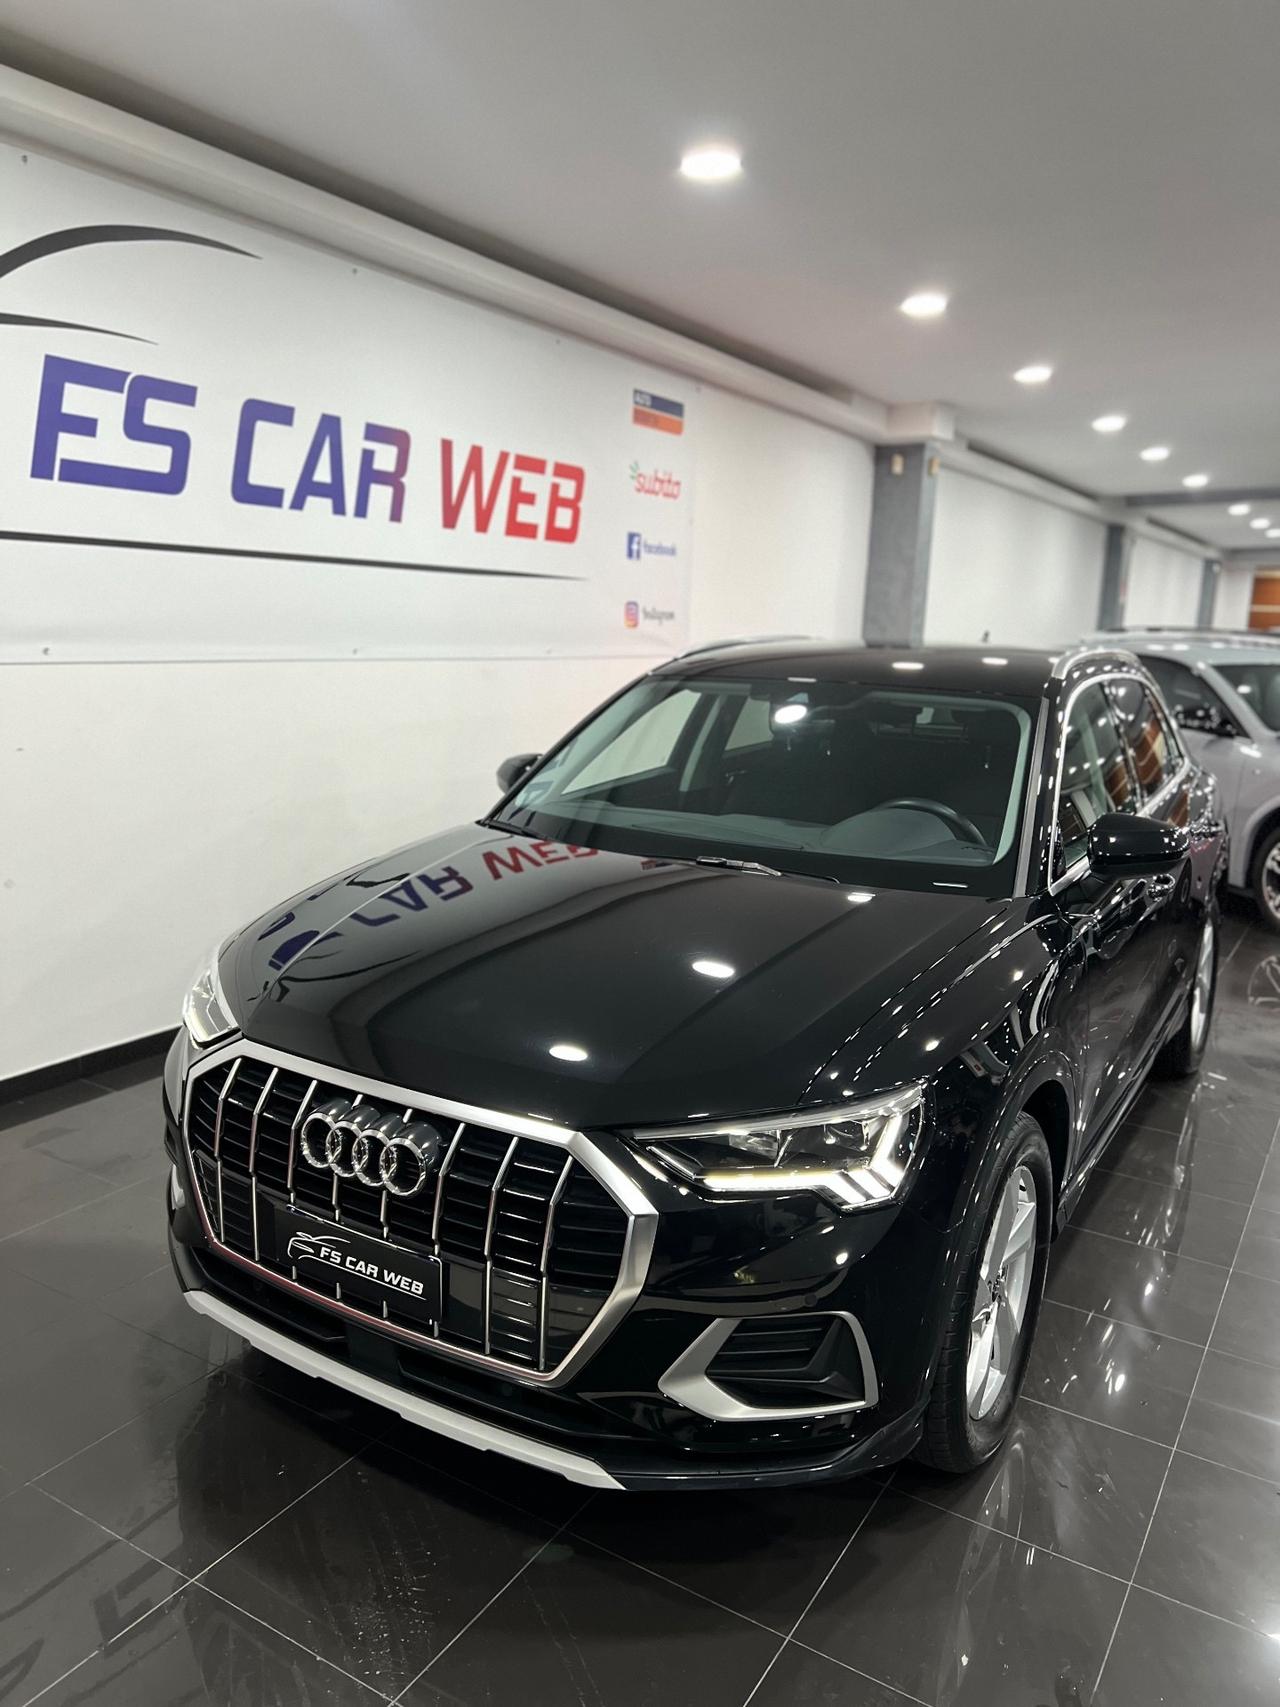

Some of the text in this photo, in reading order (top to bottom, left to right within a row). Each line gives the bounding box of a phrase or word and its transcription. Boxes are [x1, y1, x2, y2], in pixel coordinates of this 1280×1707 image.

[30, 354, 587, 544] FS CAR WEB
[320, 1247, 424, 1295] FS CAR WEB
